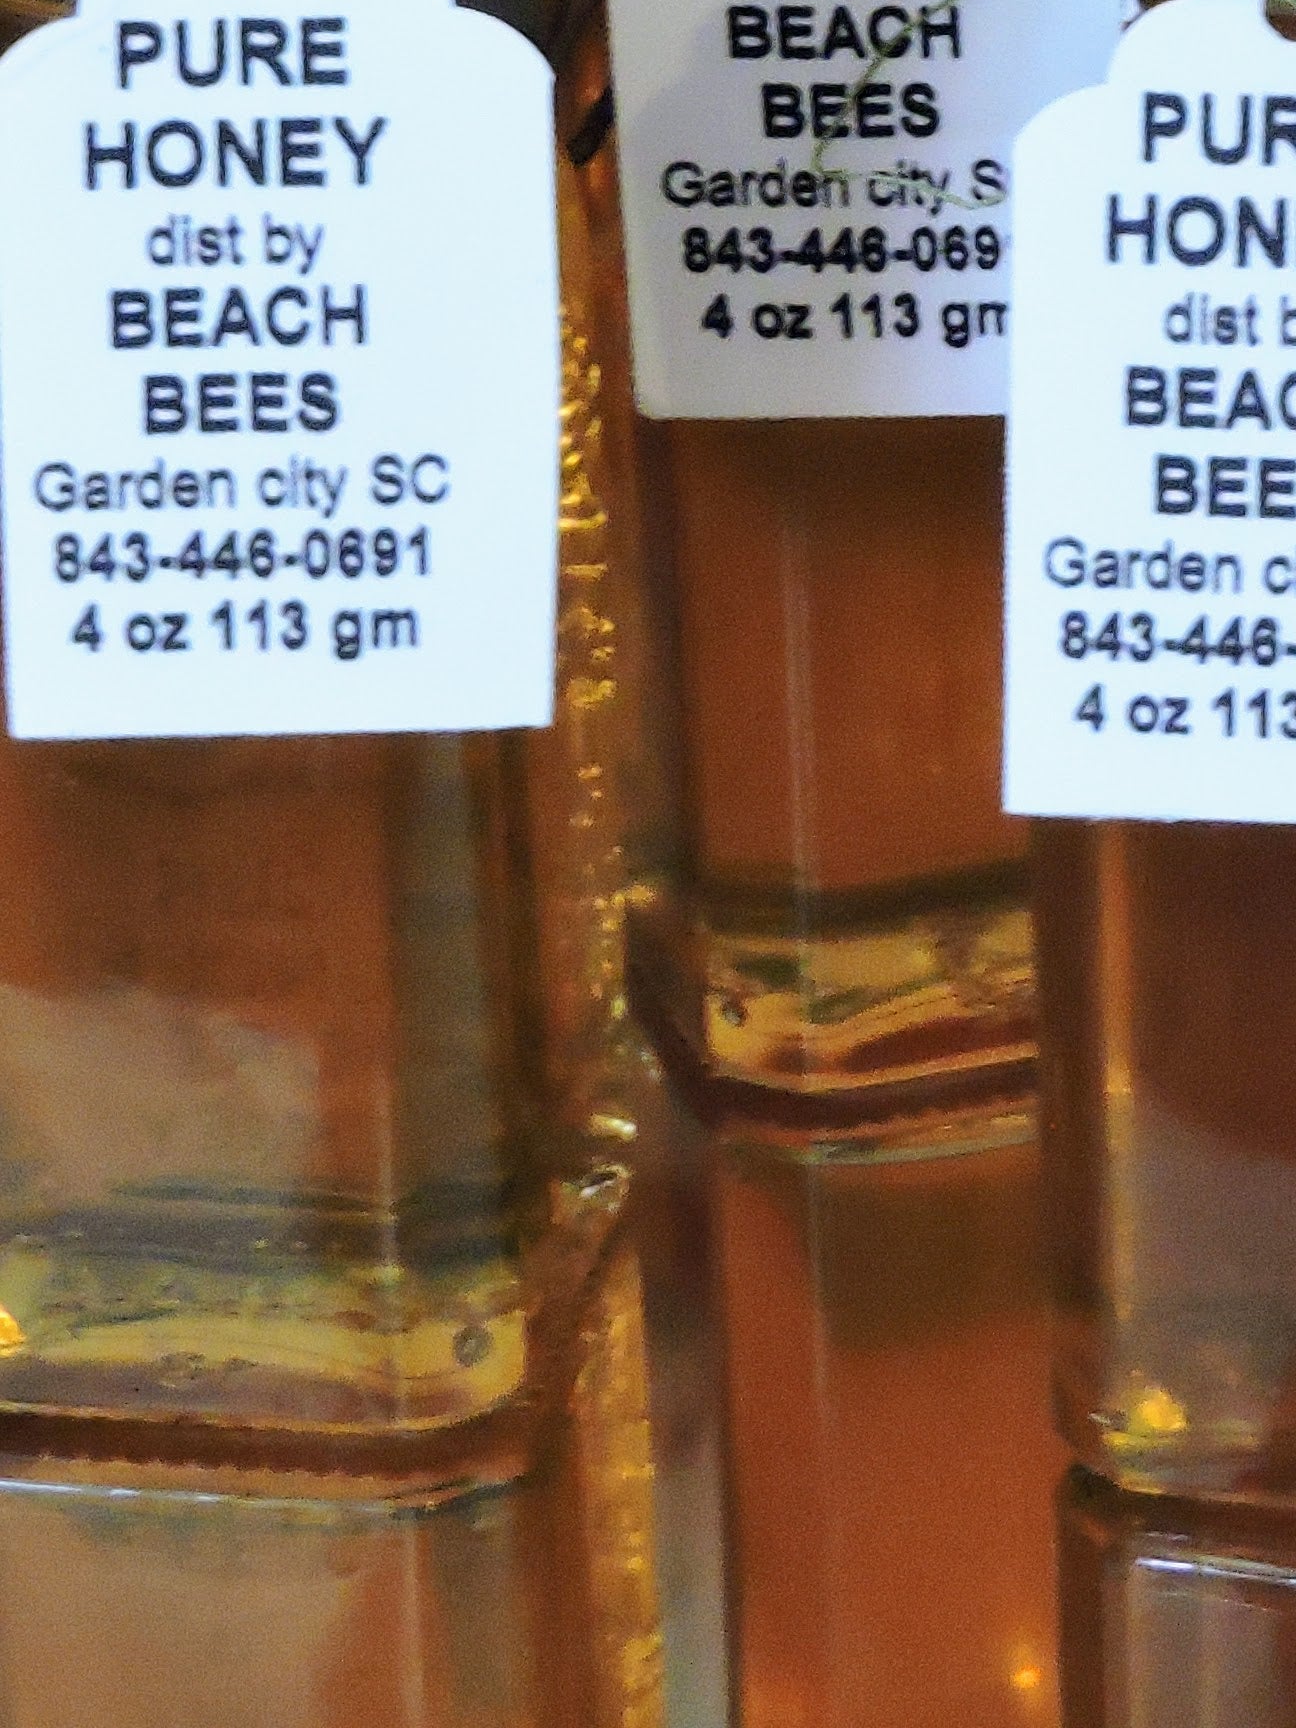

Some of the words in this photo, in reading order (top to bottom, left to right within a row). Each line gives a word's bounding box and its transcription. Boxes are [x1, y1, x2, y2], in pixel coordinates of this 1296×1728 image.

[118, 18, 349, 91] PURE
[726, 5, 961, 66] BEACH
[761, 79, 941, 142] BEES
[86, 117, 387, 192] HONEY
[662, 162, 851, 210] Garden
[972, 159, 1006, 202] S
[149, 218, 244, 268] dist
[265, 217, 323, 276] by
[682, 226, 1002, 275] 843-446-069
[111, 284, 366, 351] BEACH
[702, 294, 736, 340] 4
[752, 303, 815, 341] oz
[830, 293, 921, 340] 113
[1167, 295, 1260, 348] dist
[144, 373, 339, 437] BEES
[35, 463, 235, 514] Garden
[259, 461, 348, 520] city
[373, 454, 448, 508] SC
[56, 527, 429, 585] 843-446-0691
[1046, 537, 1243, 594] Garden
[72, 605, 103, 653] 4
[126, 613, 189, 654] oz
[212, 600, 309, 652] 113
[333, 610, 418, 663] gm
[1076, 684, 1106, 733] 4
[1128, 696, 1191, 736] oz
